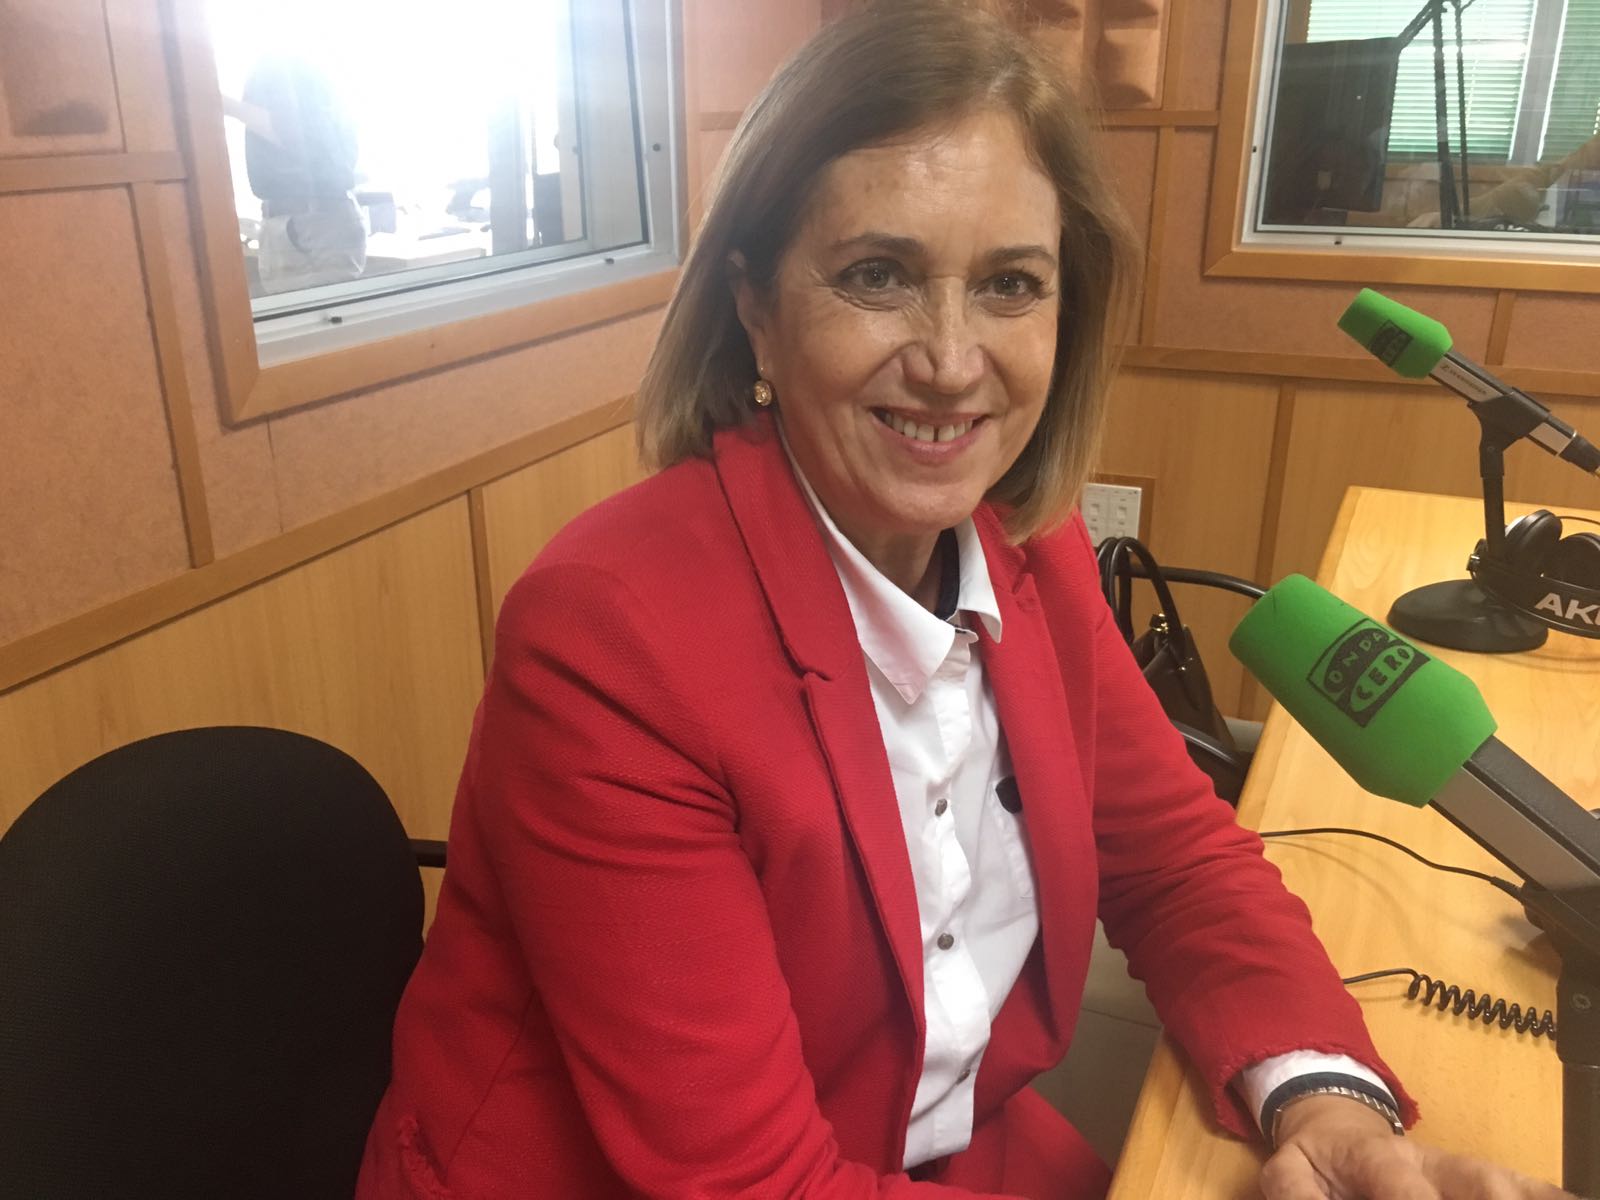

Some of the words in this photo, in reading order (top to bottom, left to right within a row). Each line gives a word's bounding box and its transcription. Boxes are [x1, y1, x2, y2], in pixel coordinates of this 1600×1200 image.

[1534, 592, 1600, 626] AK
[1328, 632, 1384, 684] ONDA
[1356, 648, 1410, 701] CERO
